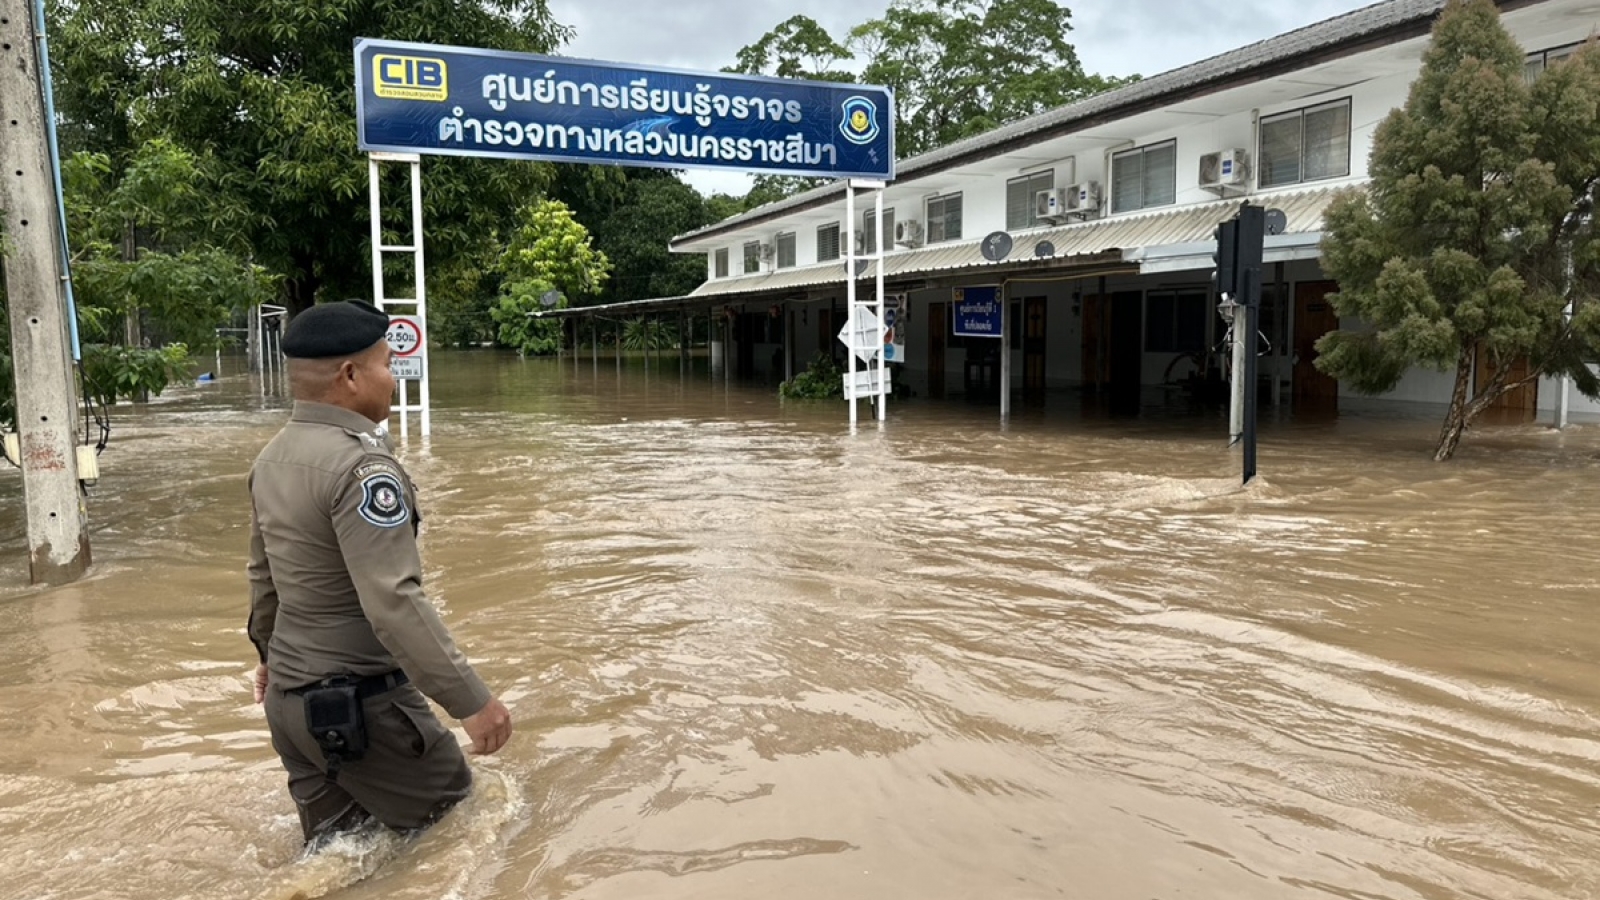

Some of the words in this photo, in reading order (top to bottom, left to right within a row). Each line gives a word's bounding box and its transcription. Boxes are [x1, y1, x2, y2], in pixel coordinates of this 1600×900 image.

[380, 58, 442, 87] CIB
[482, 69, 802, 127] ศูนย์การเรียนรู้จราจร
[439, 106, 837, 165] ตำรวจทางหลวงนครราชสีมา
